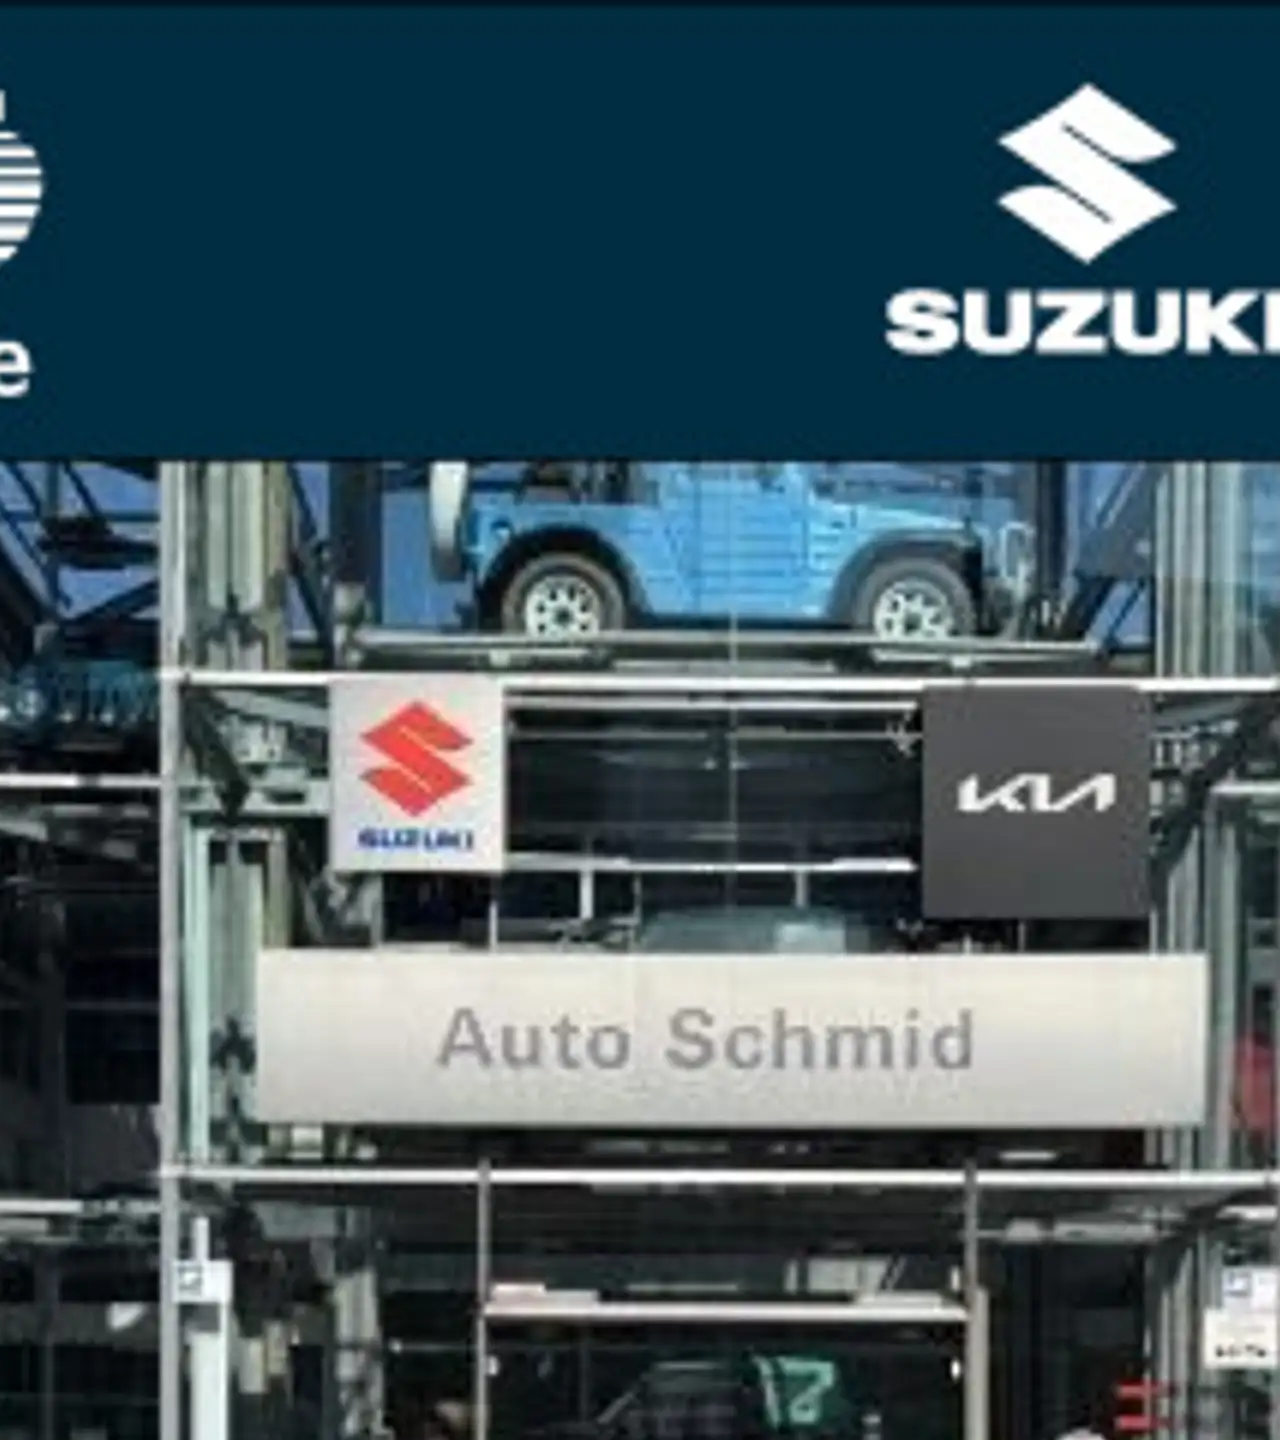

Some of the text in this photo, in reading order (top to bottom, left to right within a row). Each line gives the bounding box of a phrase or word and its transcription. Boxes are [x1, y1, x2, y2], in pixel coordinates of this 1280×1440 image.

[956, 772, 1118, 814] KIA
[357, 826, 474, 852] SUZUKI
[436, 1007, 975, 1071] Auto Schmid
